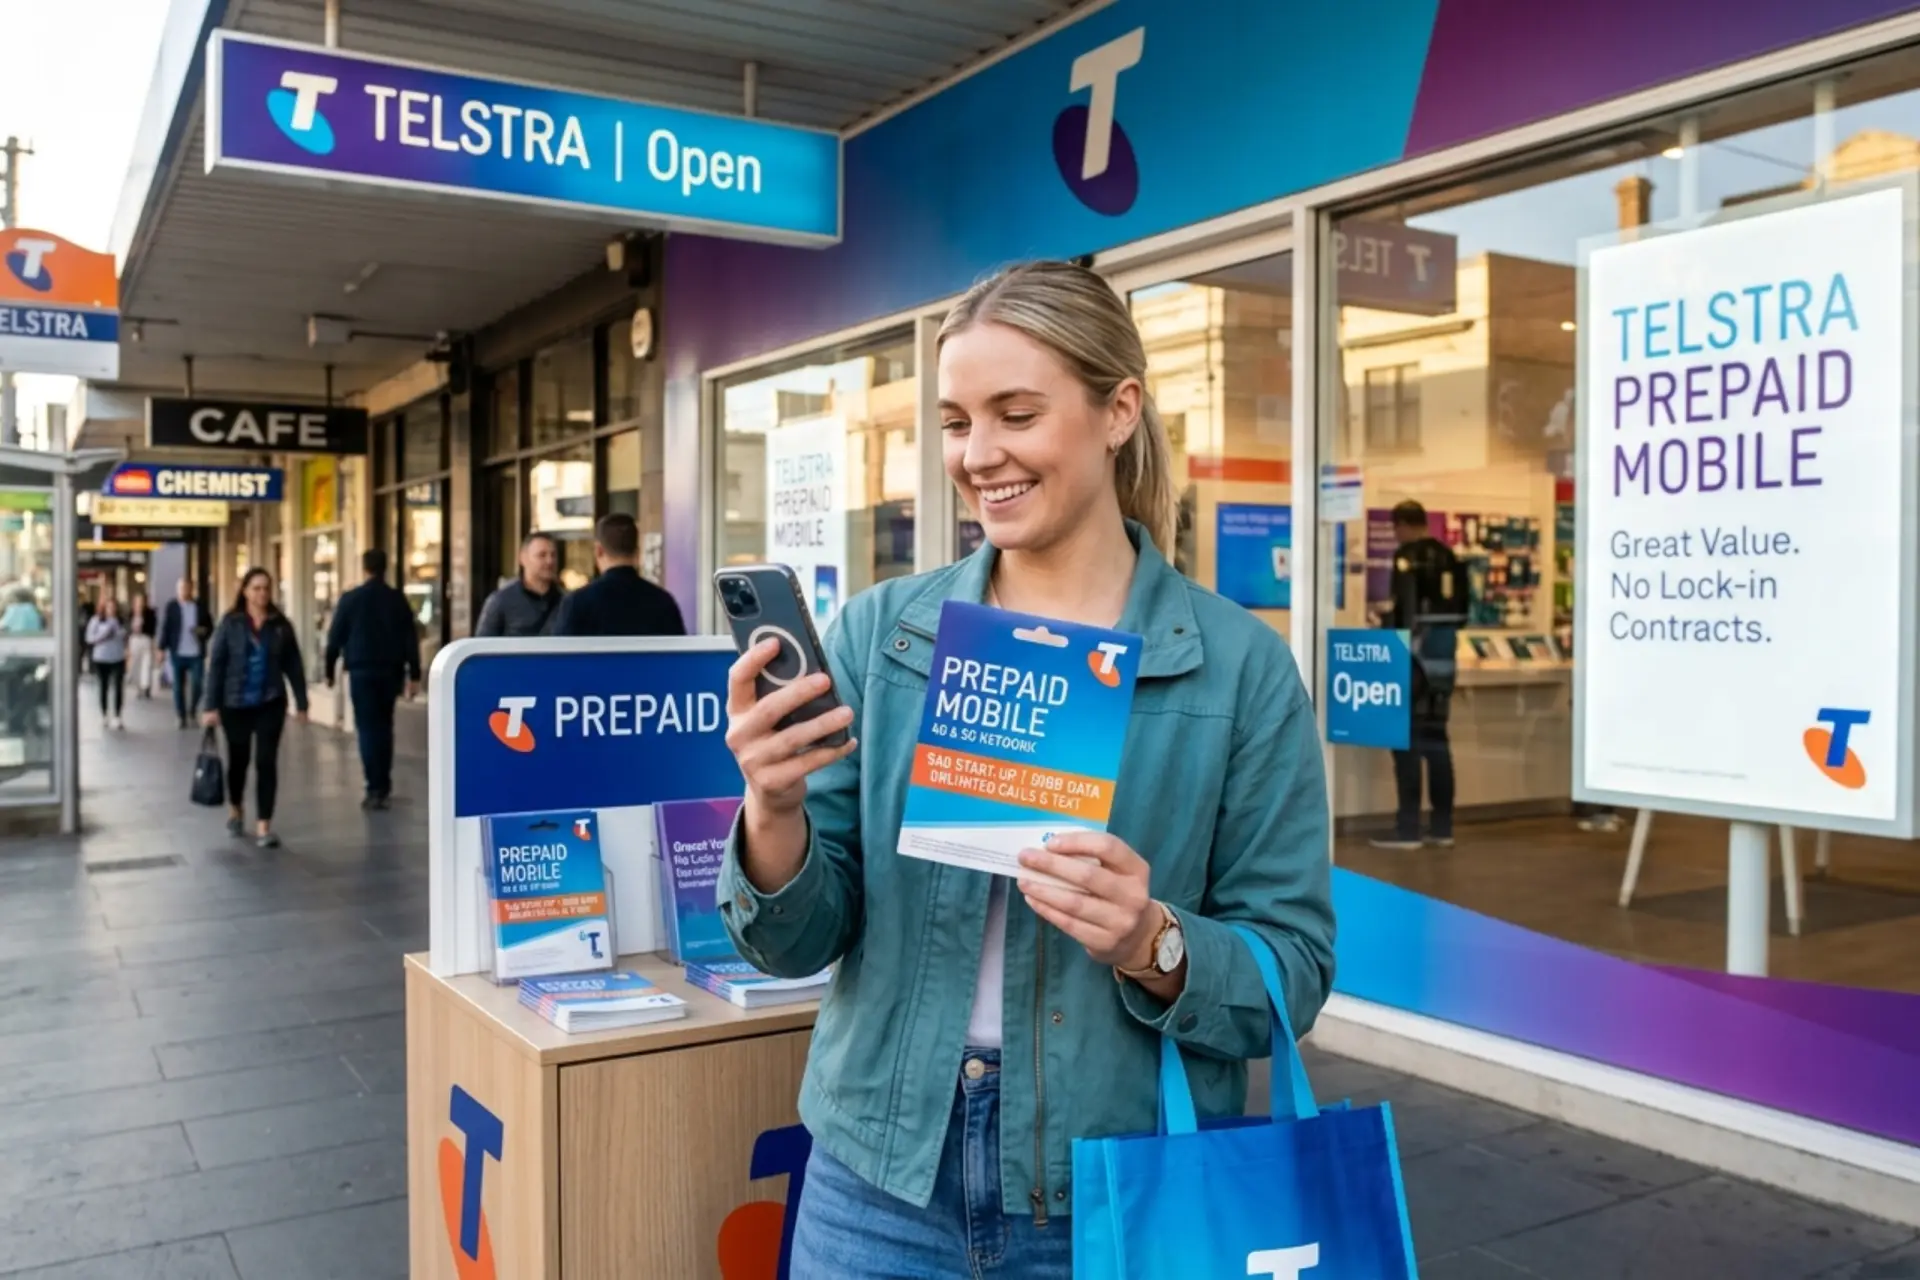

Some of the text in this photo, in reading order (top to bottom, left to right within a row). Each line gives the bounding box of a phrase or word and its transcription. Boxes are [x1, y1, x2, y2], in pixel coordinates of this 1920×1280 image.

[1069, 26, 1145, 181] T
[281, 71, 338, 131] T
[363, 84, 591, 170] TELSTRA
[647, 129, 762, 196] Open
[15, 238, 57, 279] T
[1612, 272, 1859, 362] TELSTRA
[1614, 349, 1852, 430] PREPAID
[189, 408, 329, 447] CAFE
[156, 469, 271, 498] CHEMIST
[1614, 426, 1823, 497] MOBILE
[1611, 526, 1800, 559] Great Value.
[1611, 569, 1778, 600] No Lock-in
[1610, 611, 1772, 643] Contracts.
[1097, 642, 1128, 675] T
[1333, 643, 1392, 663] TELSTRA
[941, 656, 1070, 706] PREPAID
[1333, 671, 1402, 712] Open
[498, 692, 721, 739] T PREPAID
[935, 690, 1049, 737] MOBILE
[1816, 707, 1872, 768] T
[499, 843, 568, 865] PREPAID
[449, 1083, 505, 1262] T
